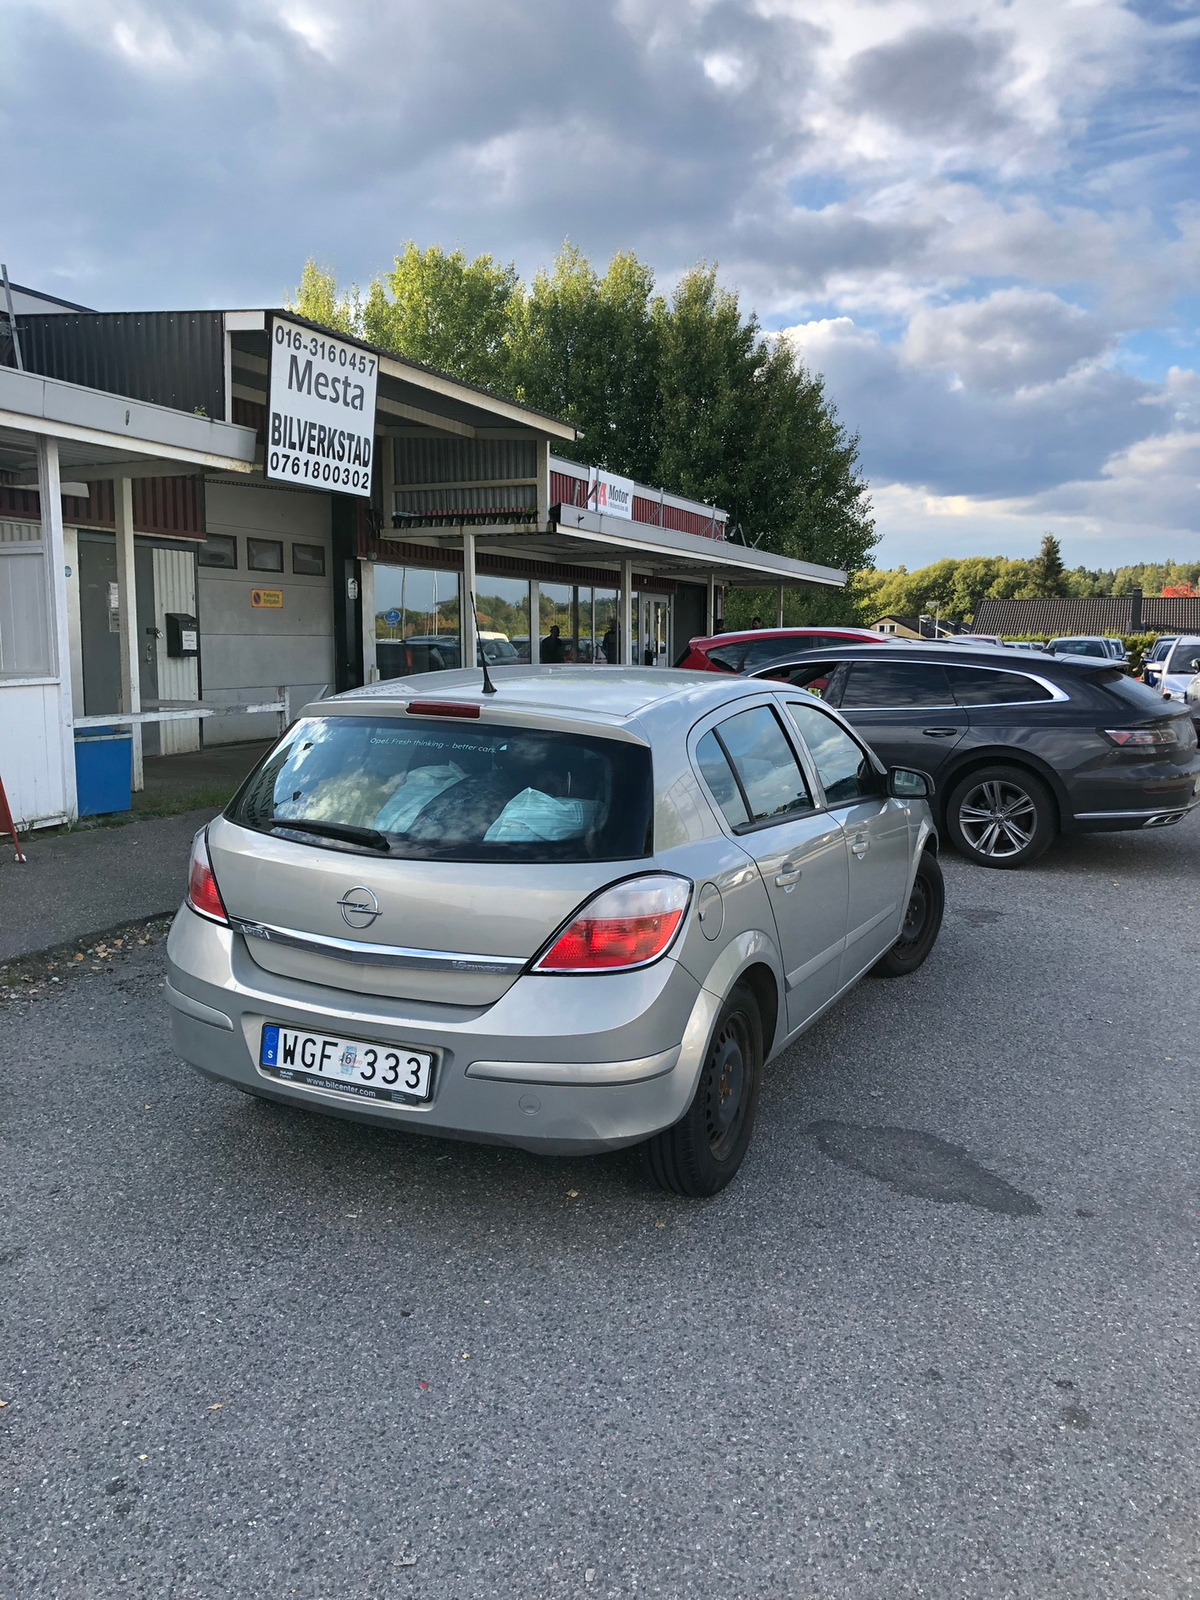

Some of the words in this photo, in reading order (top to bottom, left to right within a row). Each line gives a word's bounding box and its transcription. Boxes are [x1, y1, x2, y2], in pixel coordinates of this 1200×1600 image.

[275, 325, 376, 377] 016-3160457
[287, 354, 365, 411] Mesta
[271, 411, 371, 468] BILVERKSTAD
[270, 451, 370, 490] 0761800302
[608, 485, 629, 504] Motor
[413, 739, 444, 749] thinking
[452, 742, 476, 751] better
[267, 1049, 273, 1059] S
[283, 1033, 339, 1072] WGF
[360, 1049, 421, 1090] 333
[306, 1076, 376, 1098] www.bilcenter.com
